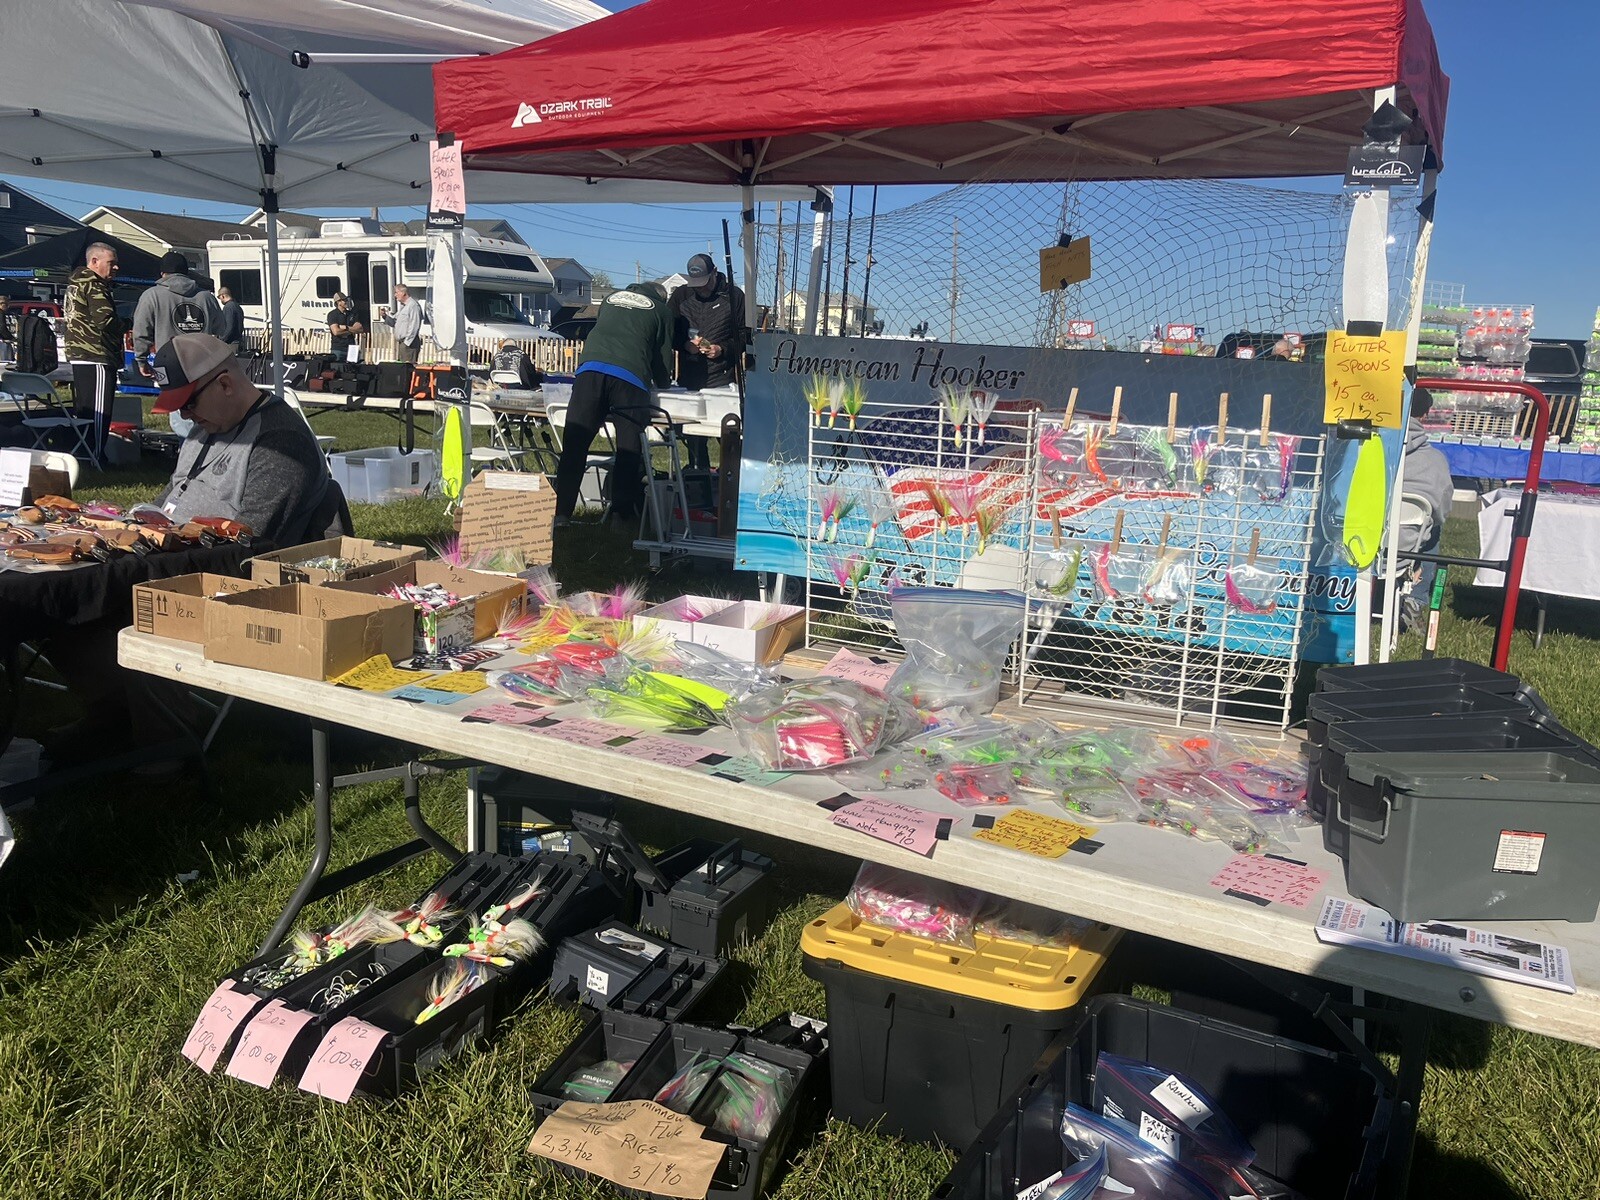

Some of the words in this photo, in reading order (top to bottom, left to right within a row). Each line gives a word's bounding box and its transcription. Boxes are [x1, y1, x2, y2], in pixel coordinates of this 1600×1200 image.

[540, 101, 578, 115] OZARK
[579, 98, 611, 110] TRAIL
[301, 300, 337, 308] Minni
[1332, 338, 1391, 354] FLUTTER
[768, 340, 900, 381] American
[910, 346, 1026, 391] Hooker
[1336, 359, 1391, 375] SPOONS
[439, 634, 454, 649] 120
[1146, 1127, 1169, 1144] PINK
[620, 1133, 658, 1155] RIGS
